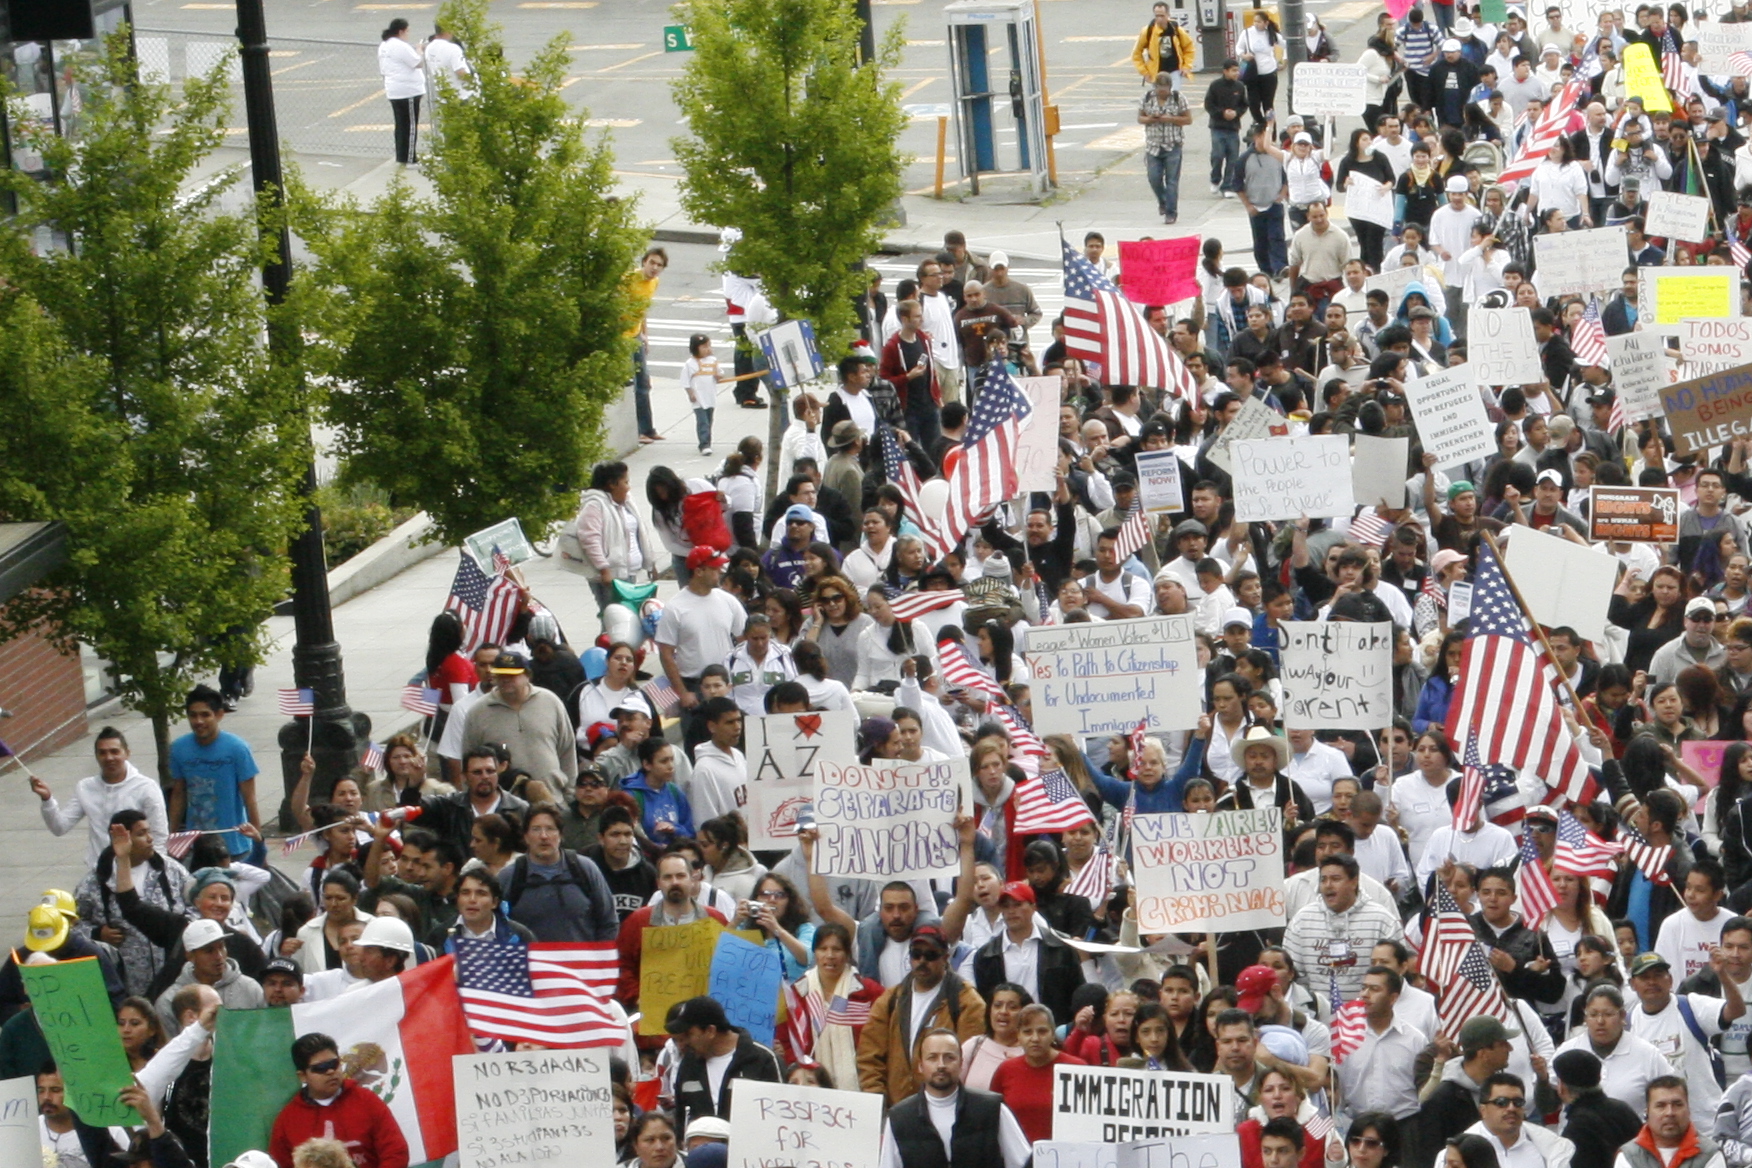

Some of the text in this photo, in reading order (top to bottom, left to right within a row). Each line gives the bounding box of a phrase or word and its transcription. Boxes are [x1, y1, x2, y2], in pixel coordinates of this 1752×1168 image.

[1683, 321, 1750, 341] TODOS
[1685, 342, 1742, 358] SOMOS
[1425, 376, 1451, 389] EQUAL
[1416, 383, 1467, 405] OPPORTUNITY
[1665, 388, 1696, 413] NO
[1418, 394, 1474, 418] FOR REFUGEES
[1442, 412, 1458, 423] AND
[1430, 418, 1478, 440] IMMIGRANTS
[1452, 442, 1487, 459] PATHWAY
[1077, 628, 1115, 648] Women
[1027, 648, 1179, 679] Yes to Path to Citizenship
[1044, 677, 1155, 707] for Undocumented
[817, 787, 959, 819] SEPARATE
[1130, 811, 1277, 842] WE ARE!
[1136, 833, 1279, 868] WORKERS
[1171, 858, 1257, 892] NOT
[474, 1062, 501, 1080] NO
[476, 1092, 502, 1110] NO
[1058, 1073, 1221, 1123] IMMIGRATION
